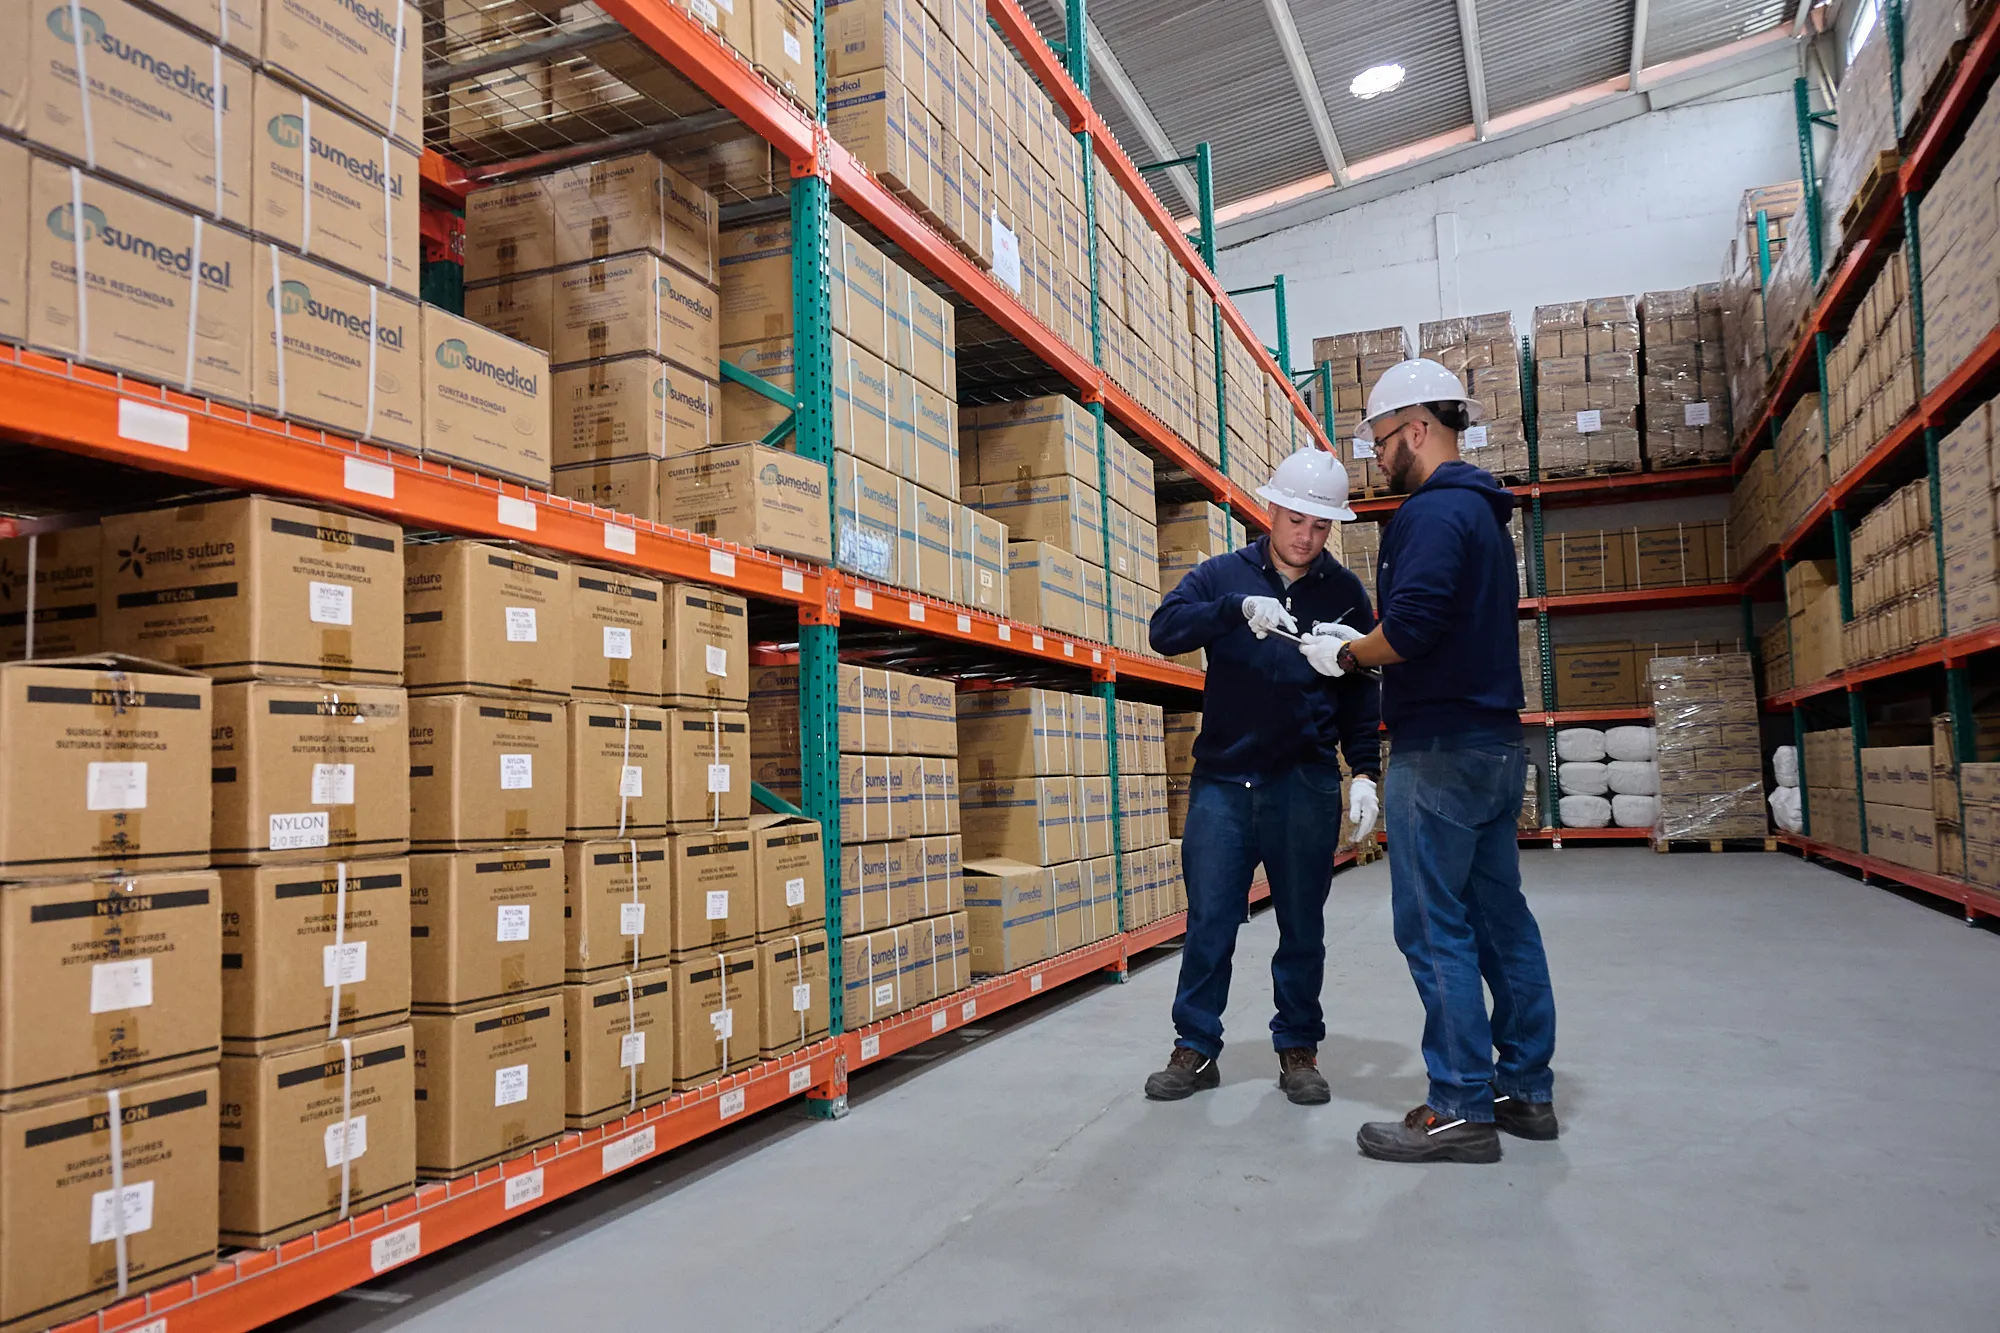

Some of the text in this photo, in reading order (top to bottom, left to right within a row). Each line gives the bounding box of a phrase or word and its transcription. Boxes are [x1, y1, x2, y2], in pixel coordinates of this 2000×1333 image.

[109, 86, 173, 121] REDONDAS
[313, 181, 361, 210] REDONDAS
[101, 225, 231, 287] sumedcal
[50, 260, 175, 307] CURTAS REDONDAS
[669, 288, 712, 319] sumedical
[307, 299, 403, 348] sumedcal
[270, 331, 361, 367] CRITAS REDONDAS
[464, 354, 537, 394] sumedical
[437, 384, 506, 413] CURITAS REDONDAS
[668, 459, 740, 478] CURITAS REDONDAS
[775, 474, 822, 496] sumedical
[316, 527, 355, 545] NYLON
[145, 545, 184, 566] smits
[187, 541, 235, 559] suture
[299, 556, 365, 573] SURGICAL SUTURES
[512, 562, 535, 574] NYLON
[292, 565, 372, 585] SUTURAS QUIRURGICAS
[407, 573, 441, 586] suture
[320, 587, 344, 597] NYLON
[606, 584, 632, 596] NYLON
[919, 691, 951, 708] sumedical
[505, 710, 528, 720] NYLON
[615, 719, 639, 729] NYON
[65, 728, 159, 739] SURGICAL SUTURES
[56, 740, 168, 751] SUTURAS QUIRURGICAS
[292, 745, 326, 753] SUTURAS
[272, 816, 324, 831] NYLON
[289, 835, 303, 845] REF
[502, 862, 526, 871] NYLON
[322, 880, 361, 893] NYON
[96, 896, 153, 915] NYLON
[344, 910, 372, 922] UTURES
[297, 919, 378, 936] SUTURAS QRURGICAS
[123, 932, 167, 945] SUTURES
[61, 943, 175, 966] SUTURAS QUIRURGICAS
[501, 1014, 526, 1027] NYLON
[502, 1070, 521, 1079] NYLON
[300, 1096, 381, 1124] SUTURAS QUURGICAS
[333, 1123, 358, 1136] NYON
[56, 1150, 172, 1188] SUTURAS QRURGICAS
[66, 1153, 113, 1172] SURGICA
[515, 1176, 533, 1188] NYLON
[384, 1233, 406, 1247] NYLON
